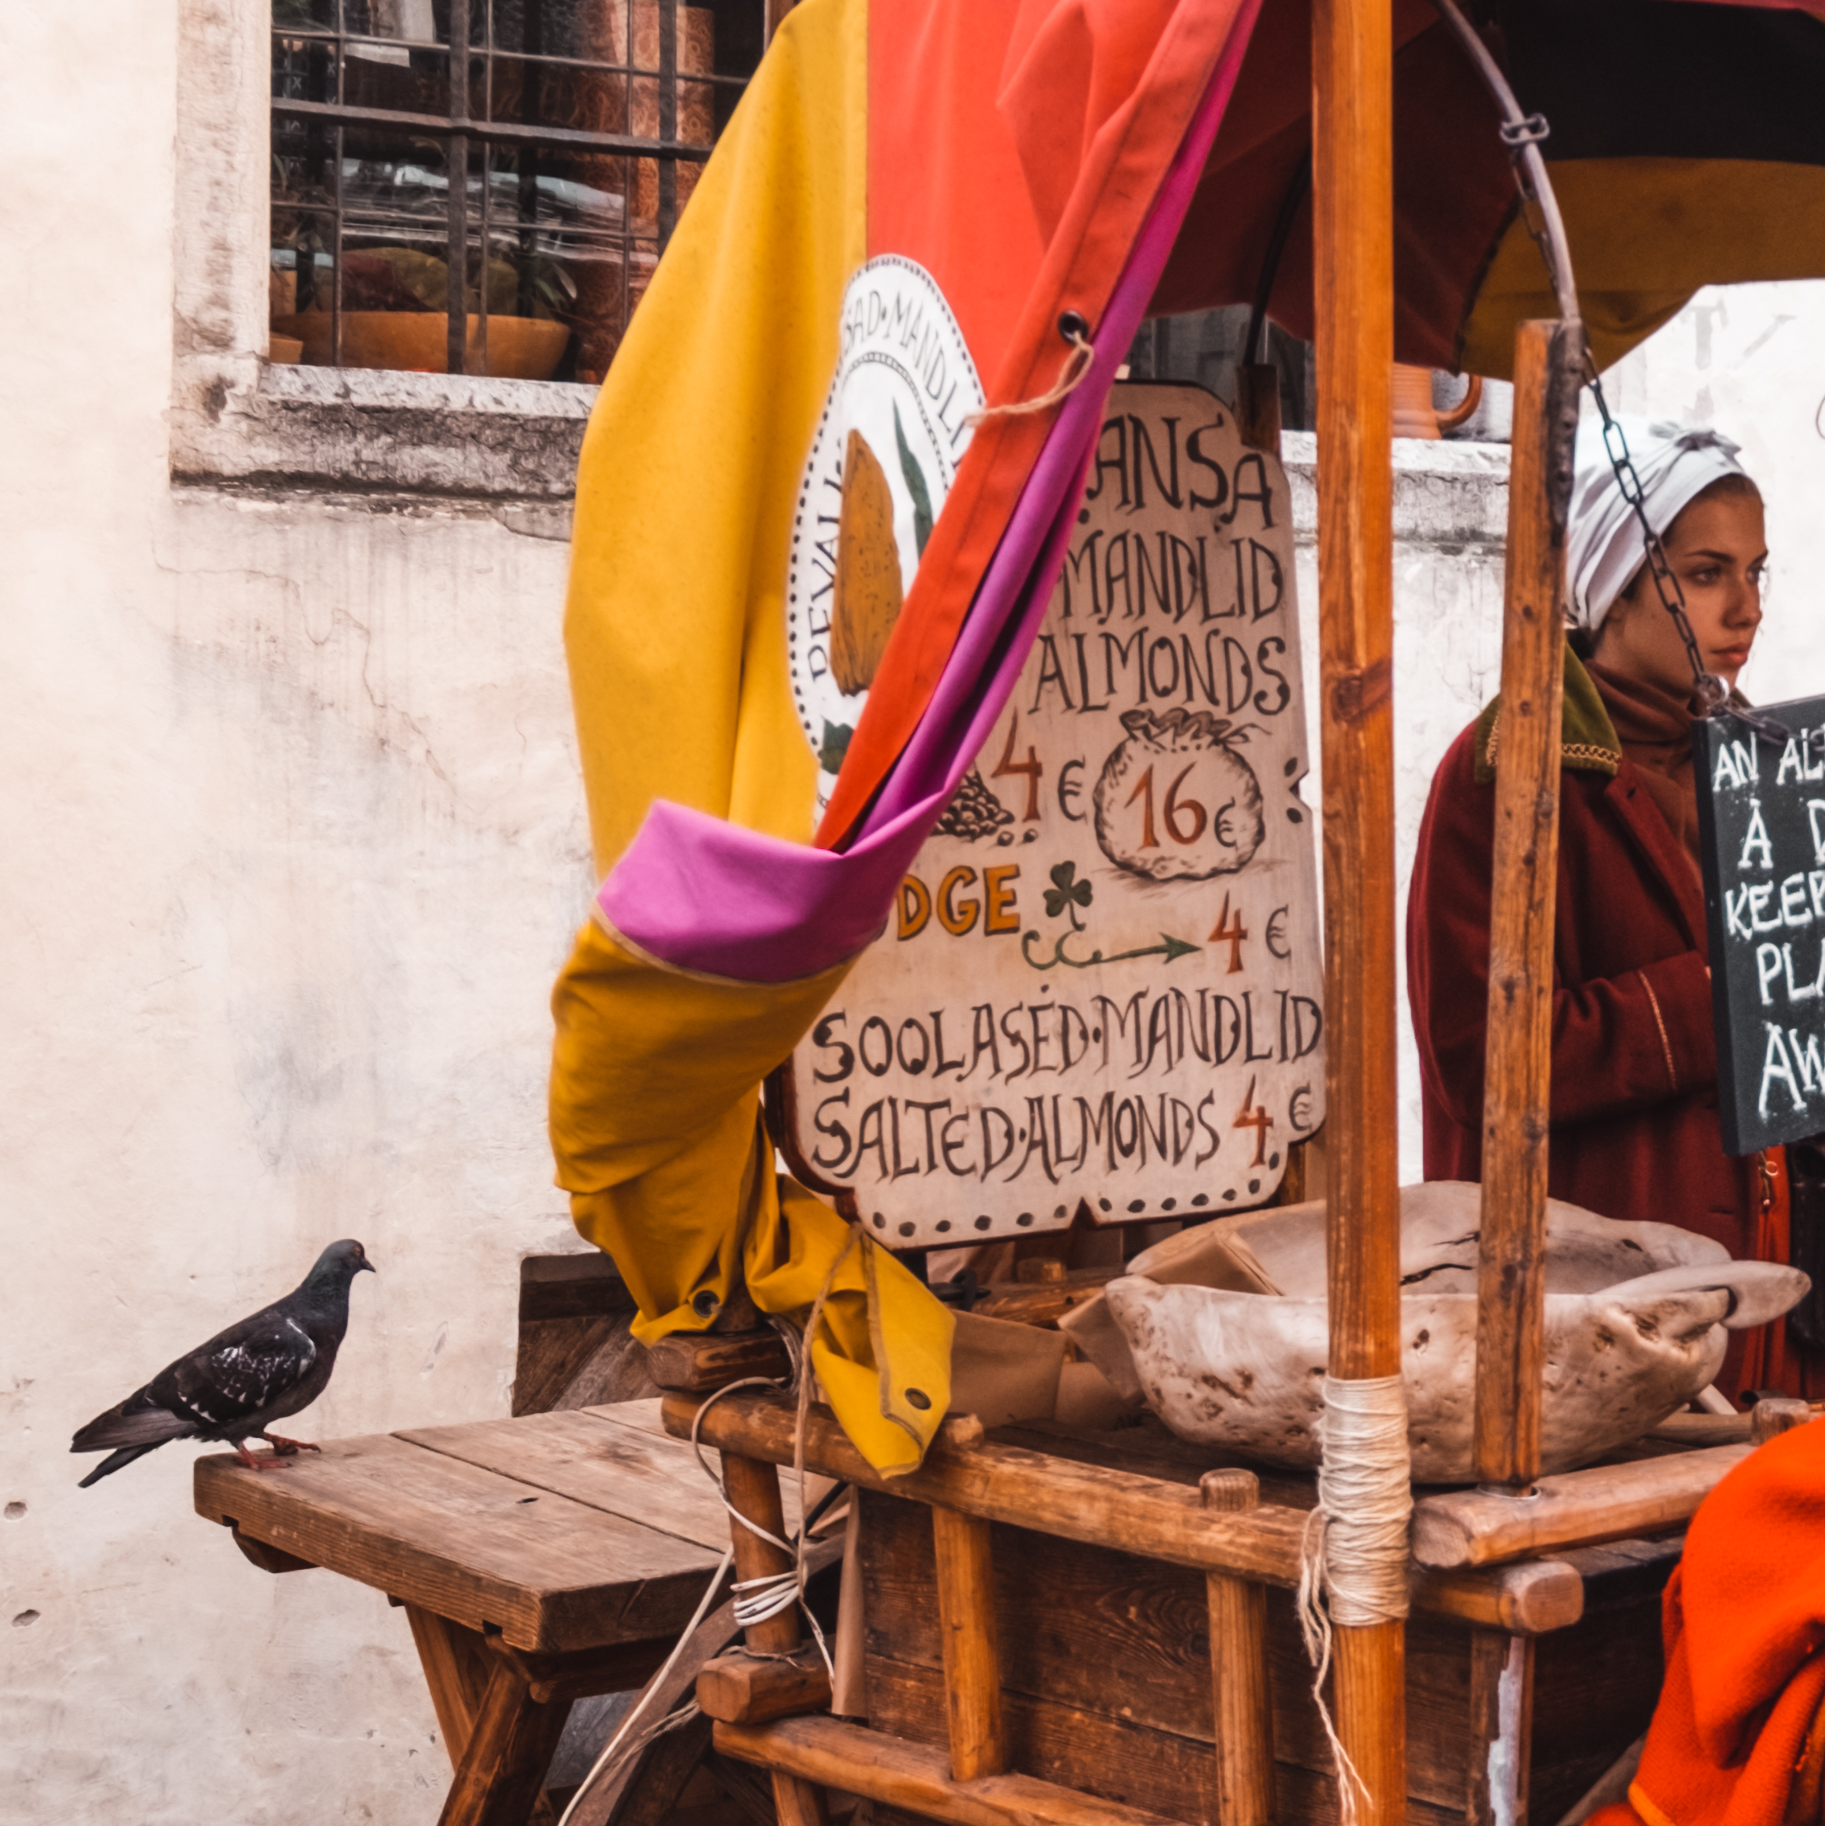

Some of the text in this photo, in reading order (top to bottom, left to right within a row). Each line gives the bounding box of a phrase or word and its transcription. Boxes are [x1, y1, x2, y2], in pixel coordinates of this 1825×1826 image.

[1057, 528, 1284, 625] MANDLID
[1027, 626, 1291, 717] ALMONDS
[1713, 732, 1759, 792] AN
[1738, 797, 1774, 869] A
